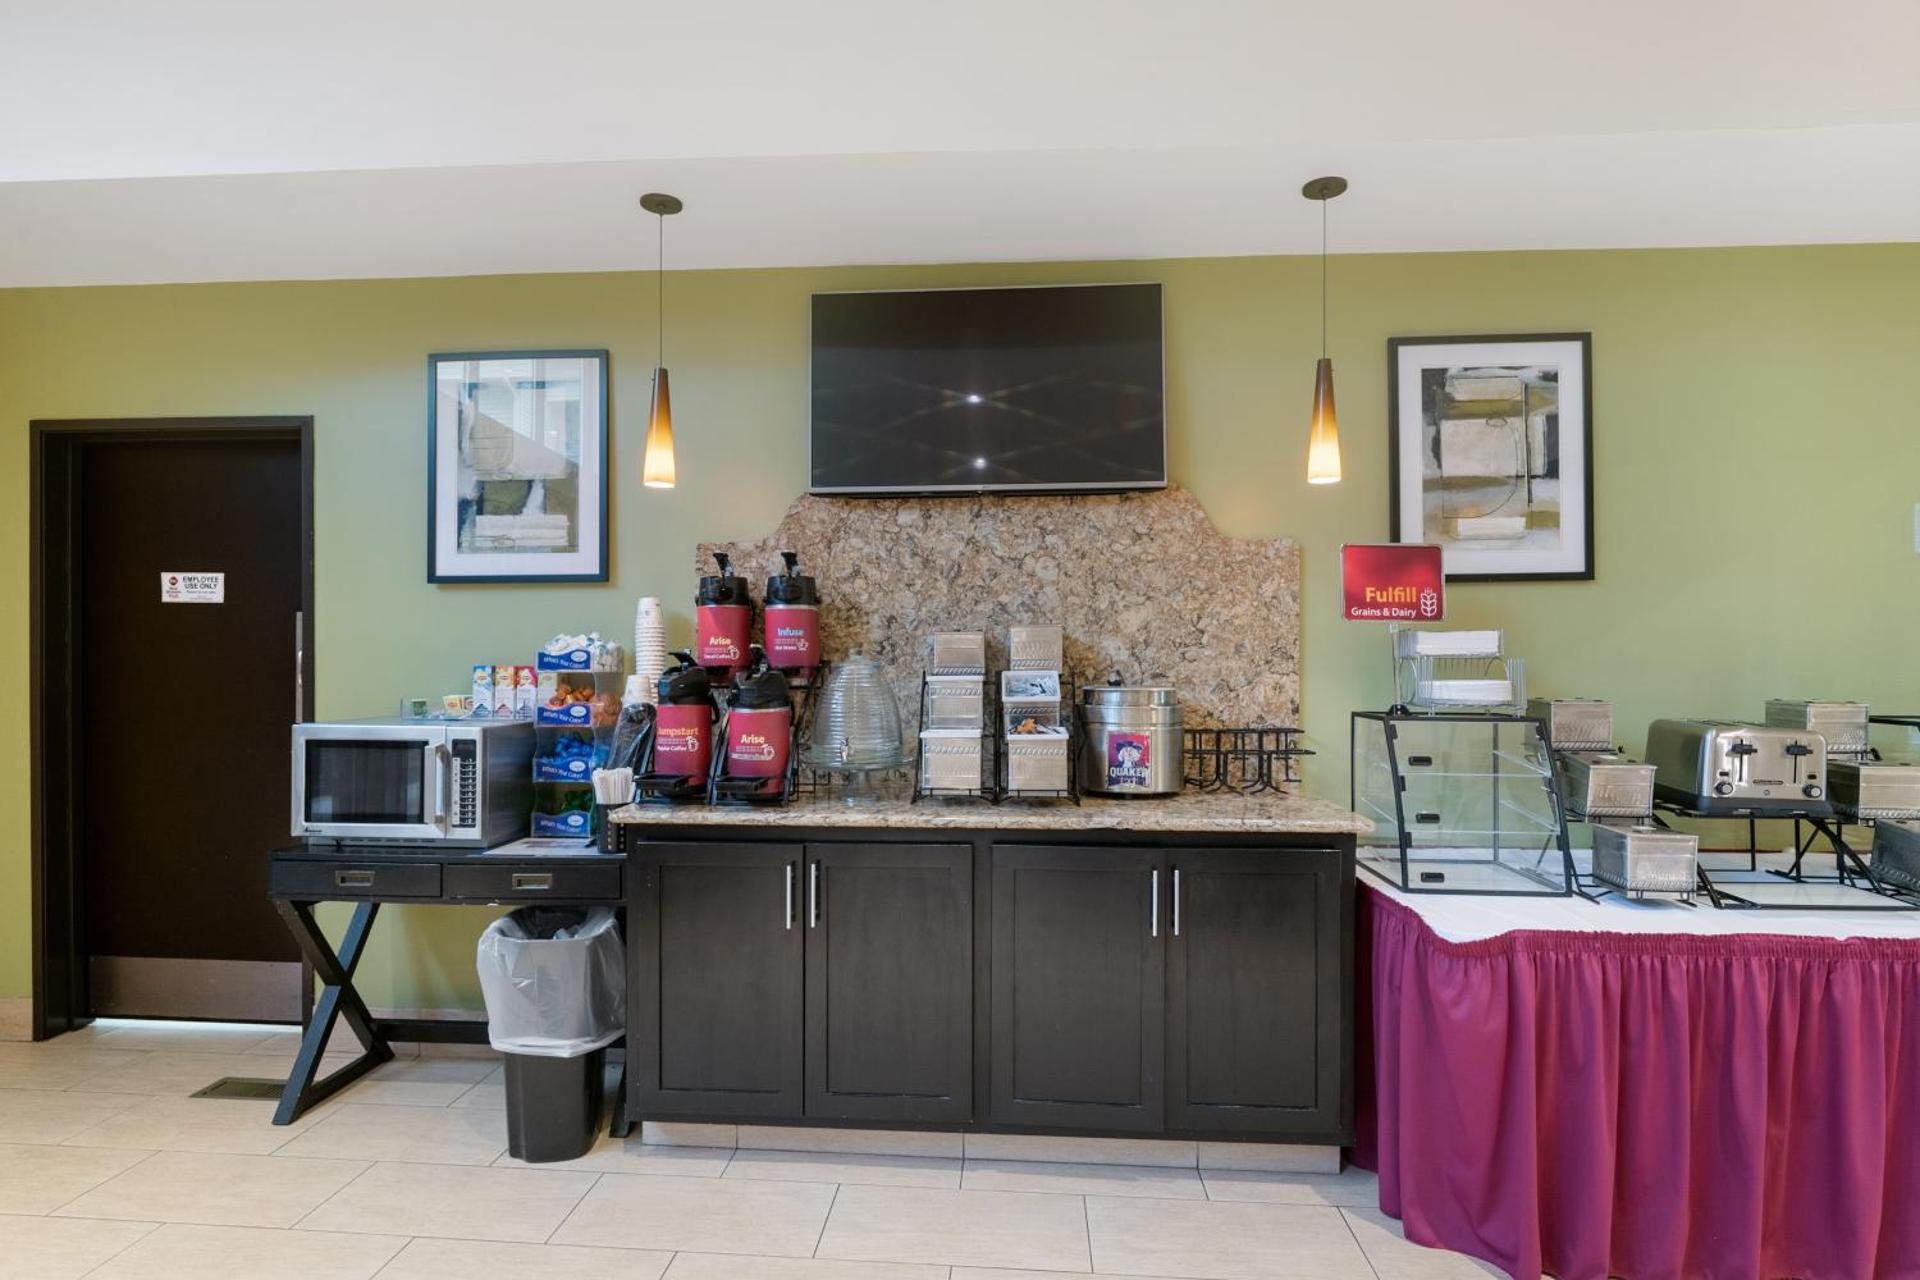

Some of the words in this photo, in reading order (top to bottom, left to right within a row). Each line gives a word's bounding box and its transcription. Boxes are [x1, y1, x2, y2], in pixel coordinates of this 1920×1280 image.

[1365, 586, 1417, 603] Fulfill
[1351, 607, 1381, 616] Grains
[1382, 607, 1390, 616] &
[1392, 607, 1417, 618] Dairy
[777, 627, 804, 636] Infuse
[709, 637, 732, 646] Arise
[657, 727, 699, 737] Jumpstart
[740, 734, 765, 744] Arise
